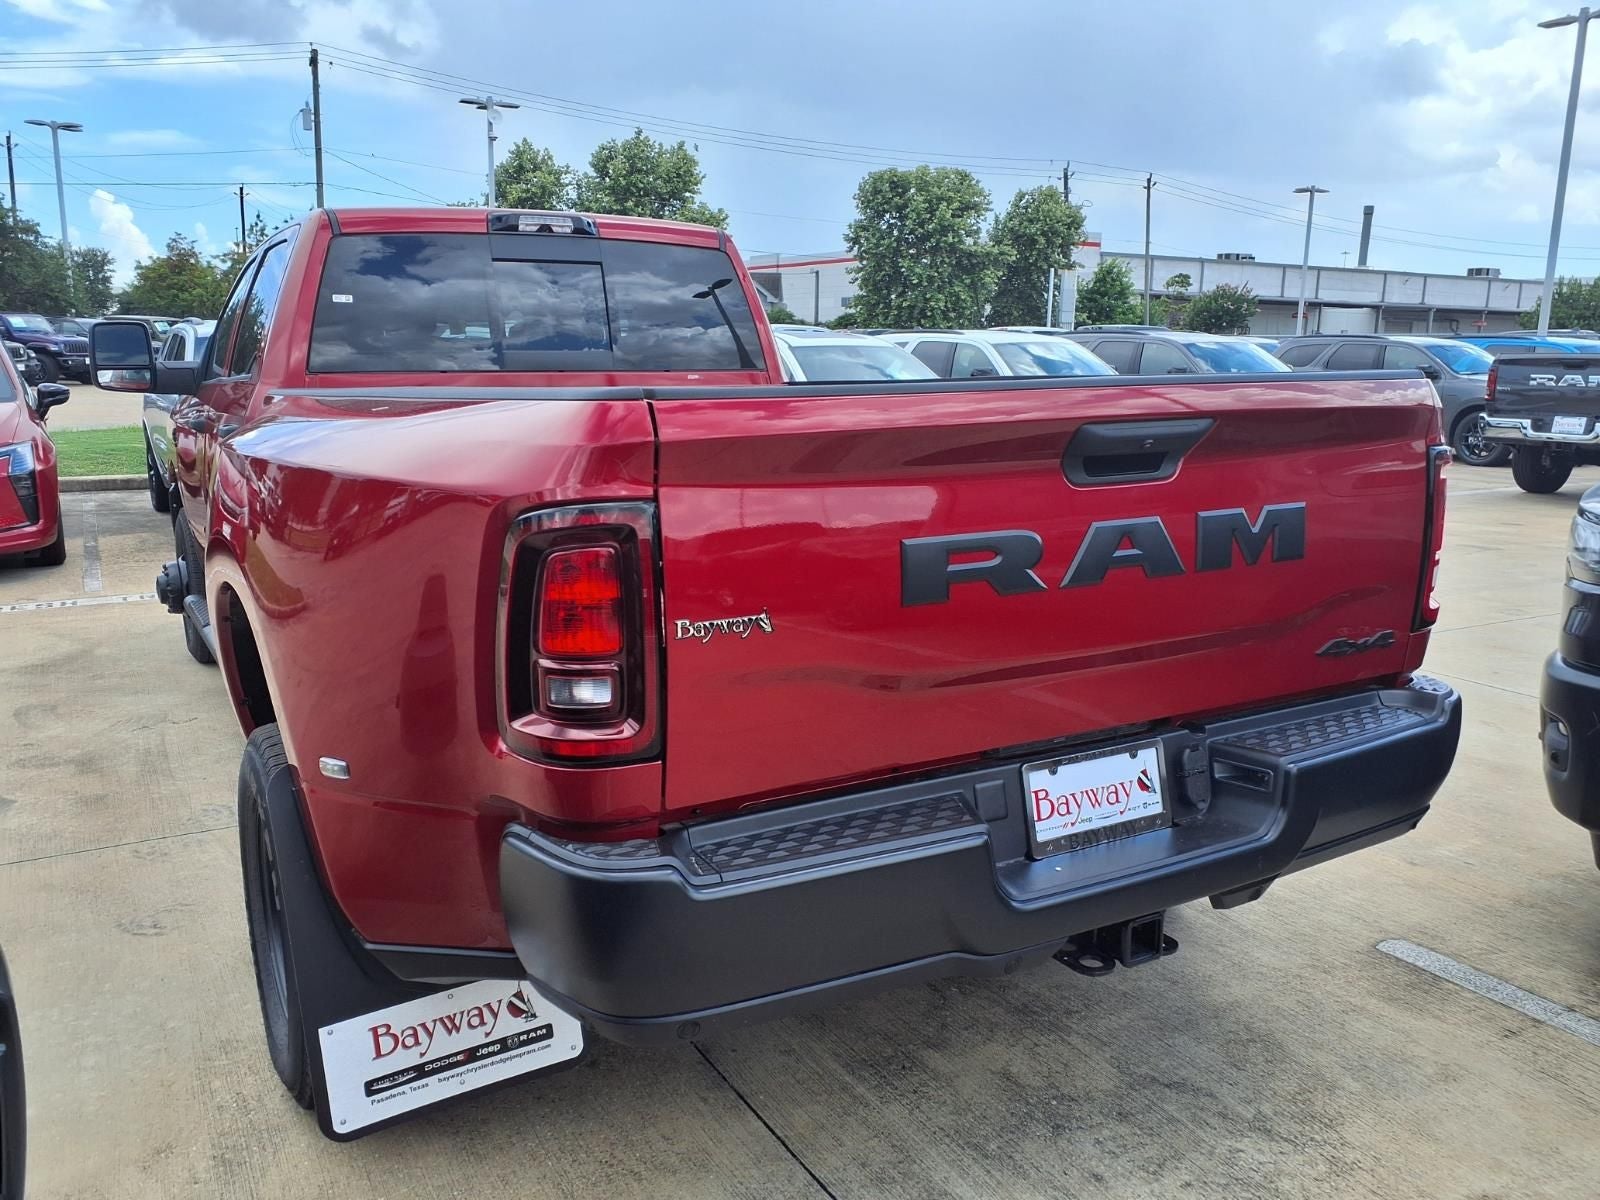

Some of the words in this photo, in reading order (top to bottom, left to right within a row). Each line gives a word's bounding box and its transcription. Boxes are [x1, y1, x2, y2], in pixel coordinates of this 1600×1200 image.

[900, 501, 1306, 607] RAM
[674, 615, 758, 643] Bayway
[1032, 780, 1133, 827] Bayway
[1078, 815, 1093, 825] Jeep
[368, 998, 503, 1061] Bayway
[424, 1053, 465, 1071] DODGE
[476, 1042, 501, 1057] Jeep
[519, 1028, 547, 1042] RAM
[371, 1090, 408, 1106] Pasadena,
[409, 1082, 429, 1095] Texas
